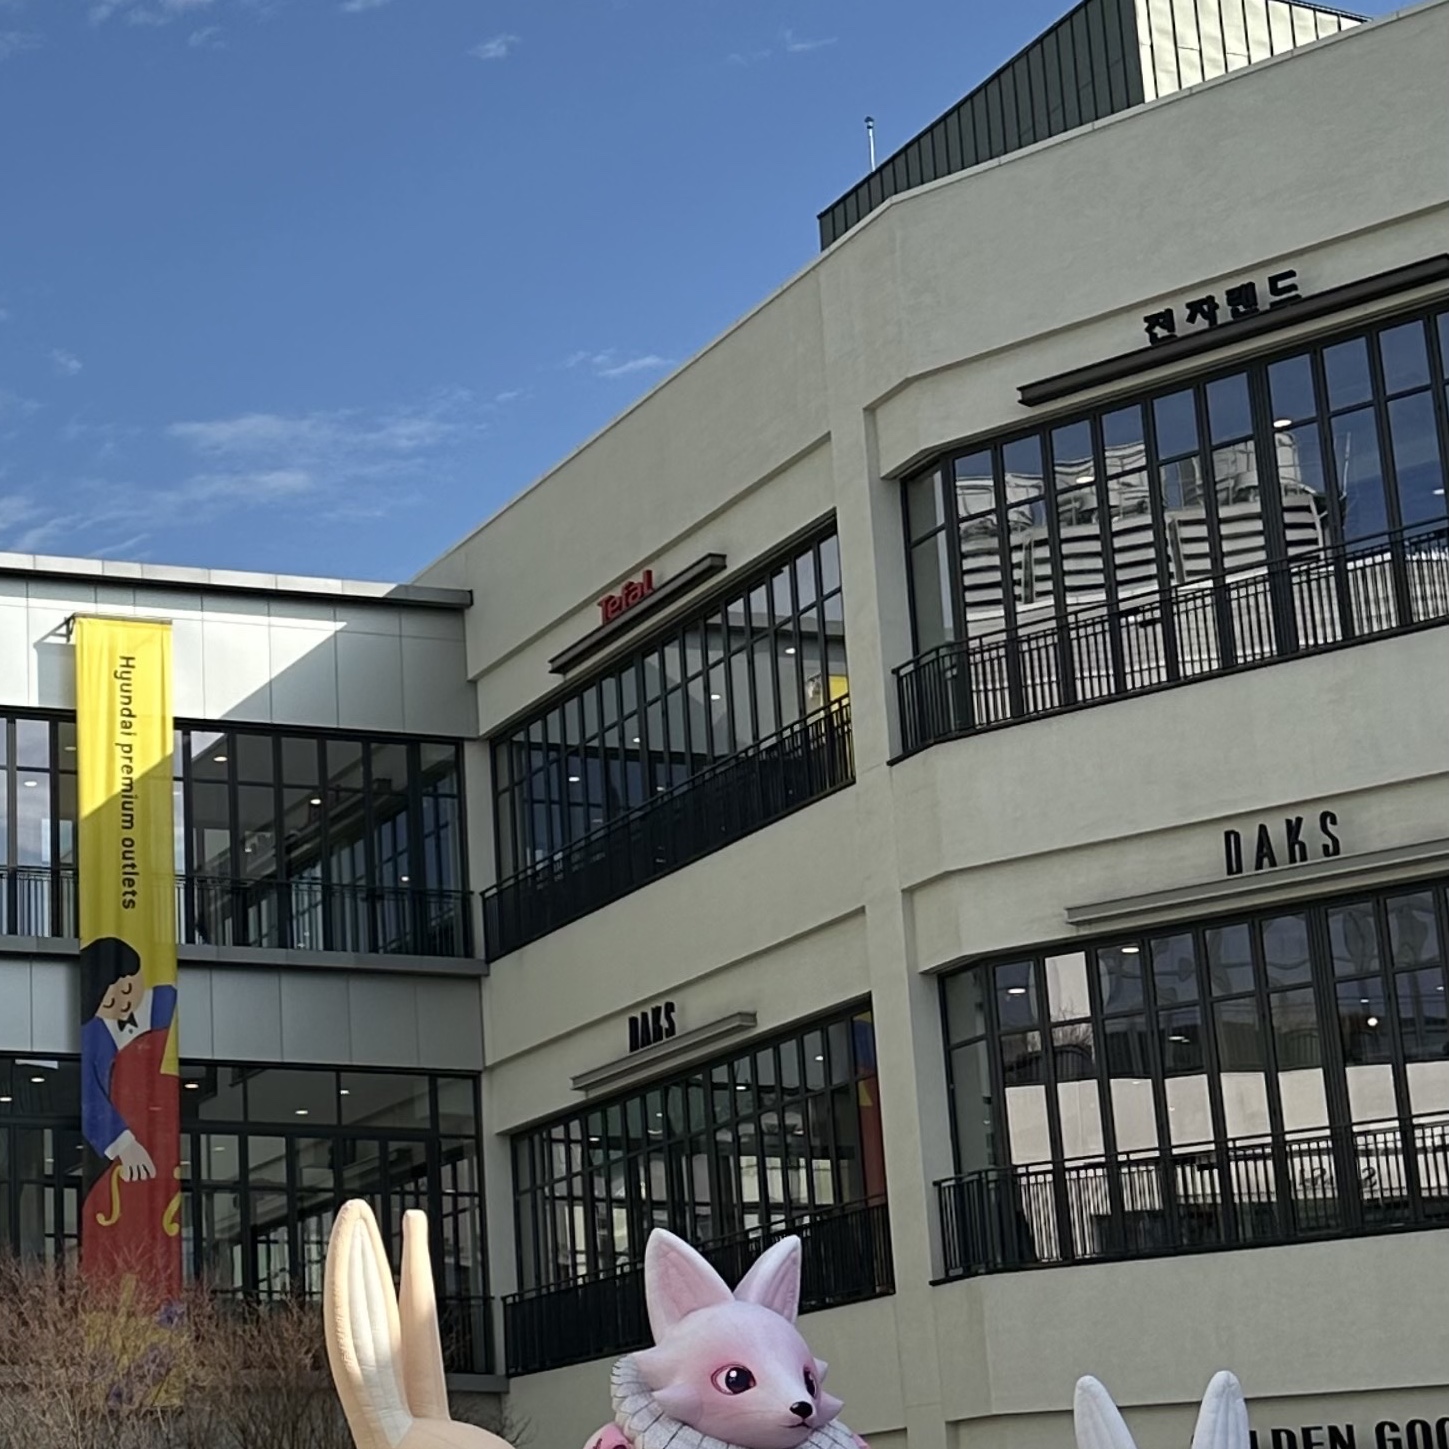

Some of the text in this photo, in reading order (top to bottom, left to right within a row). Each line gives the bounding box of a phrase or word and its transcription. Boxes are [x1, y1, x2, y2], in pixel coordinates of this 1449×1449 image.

[597, 569, 655, 625] Tefal
[114, 655, 140, 910] Hyundai premium outlets
[1224, 810, 1341, 876] DAKS
[628, 1001, 677, 1053] DAKS
